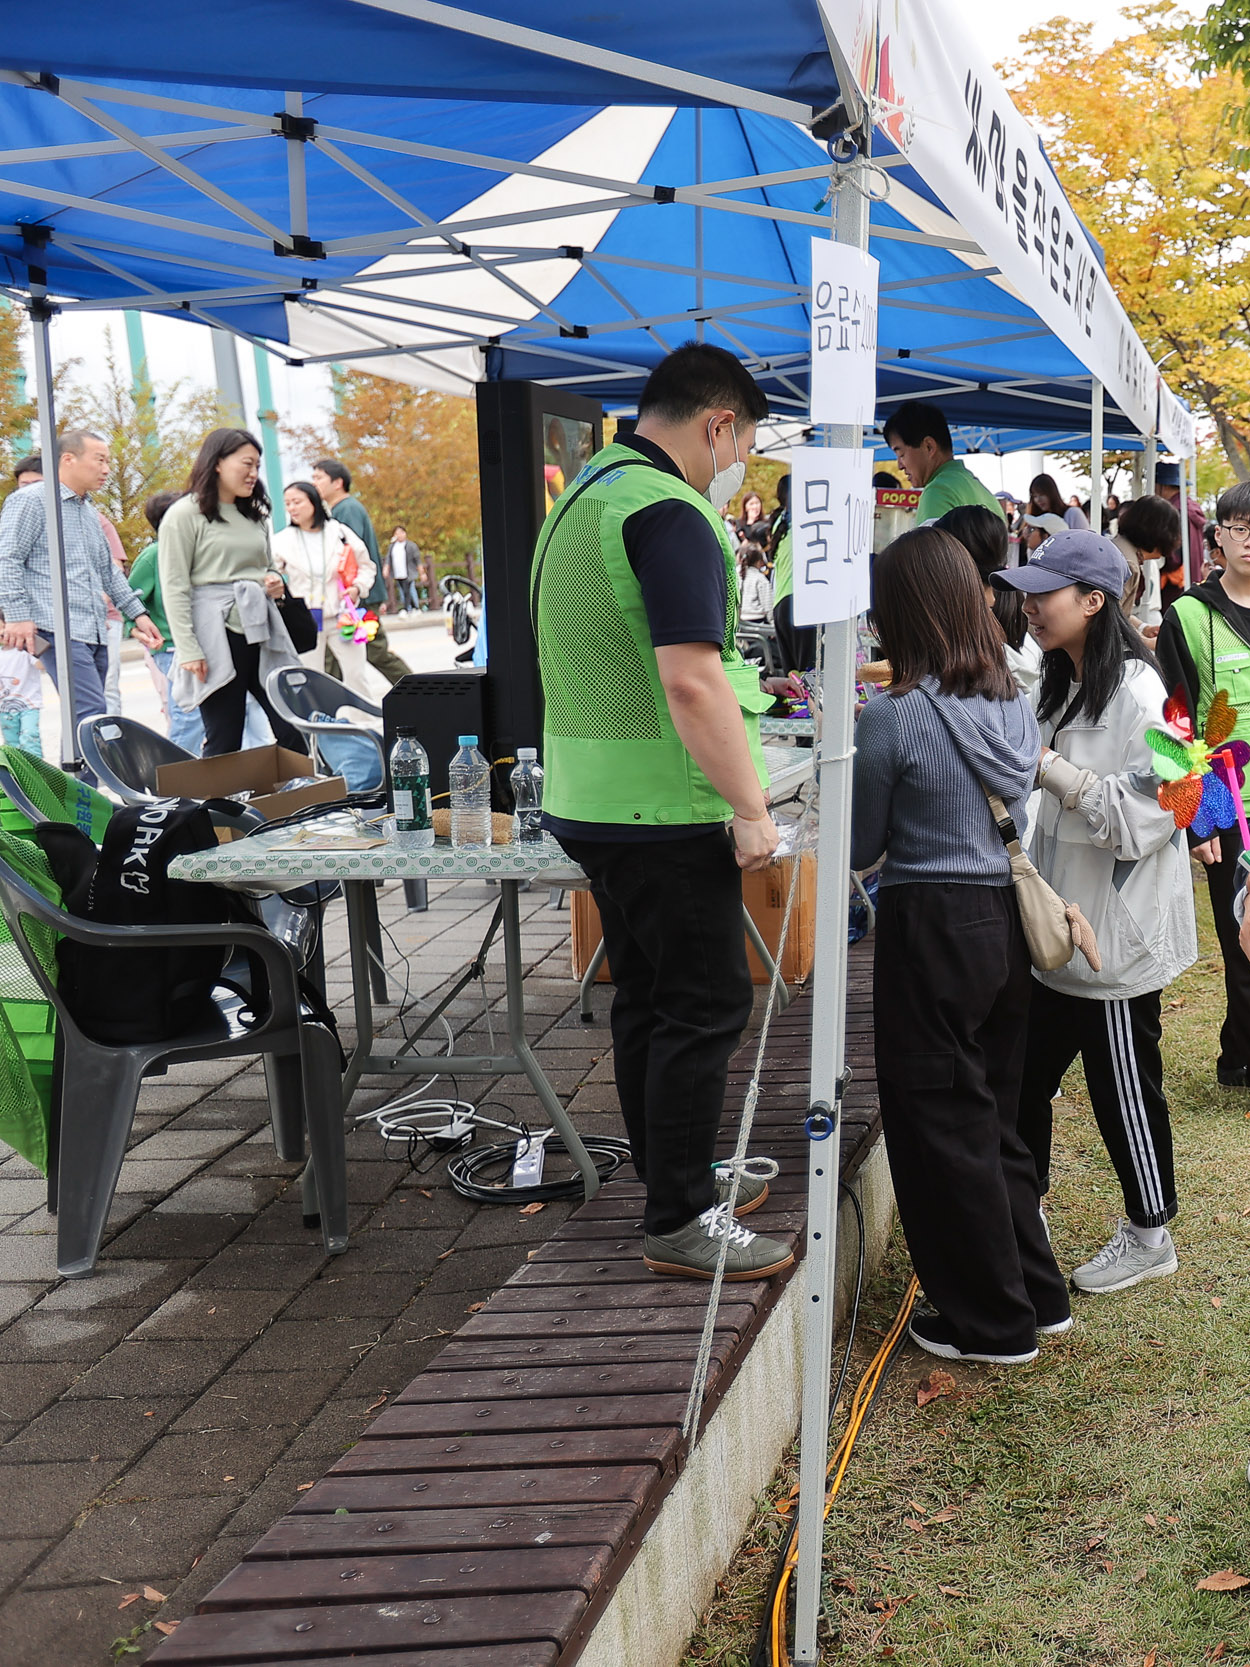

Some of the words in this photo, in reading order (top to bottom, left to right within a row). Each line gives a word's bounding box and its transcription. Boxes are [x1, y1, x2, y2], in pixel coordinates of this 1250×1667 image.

[964, 69, 1097, 339] 새마을작은도서관
[799, 479, 834, 585] 물
[882, 492, 907, 504] POP
